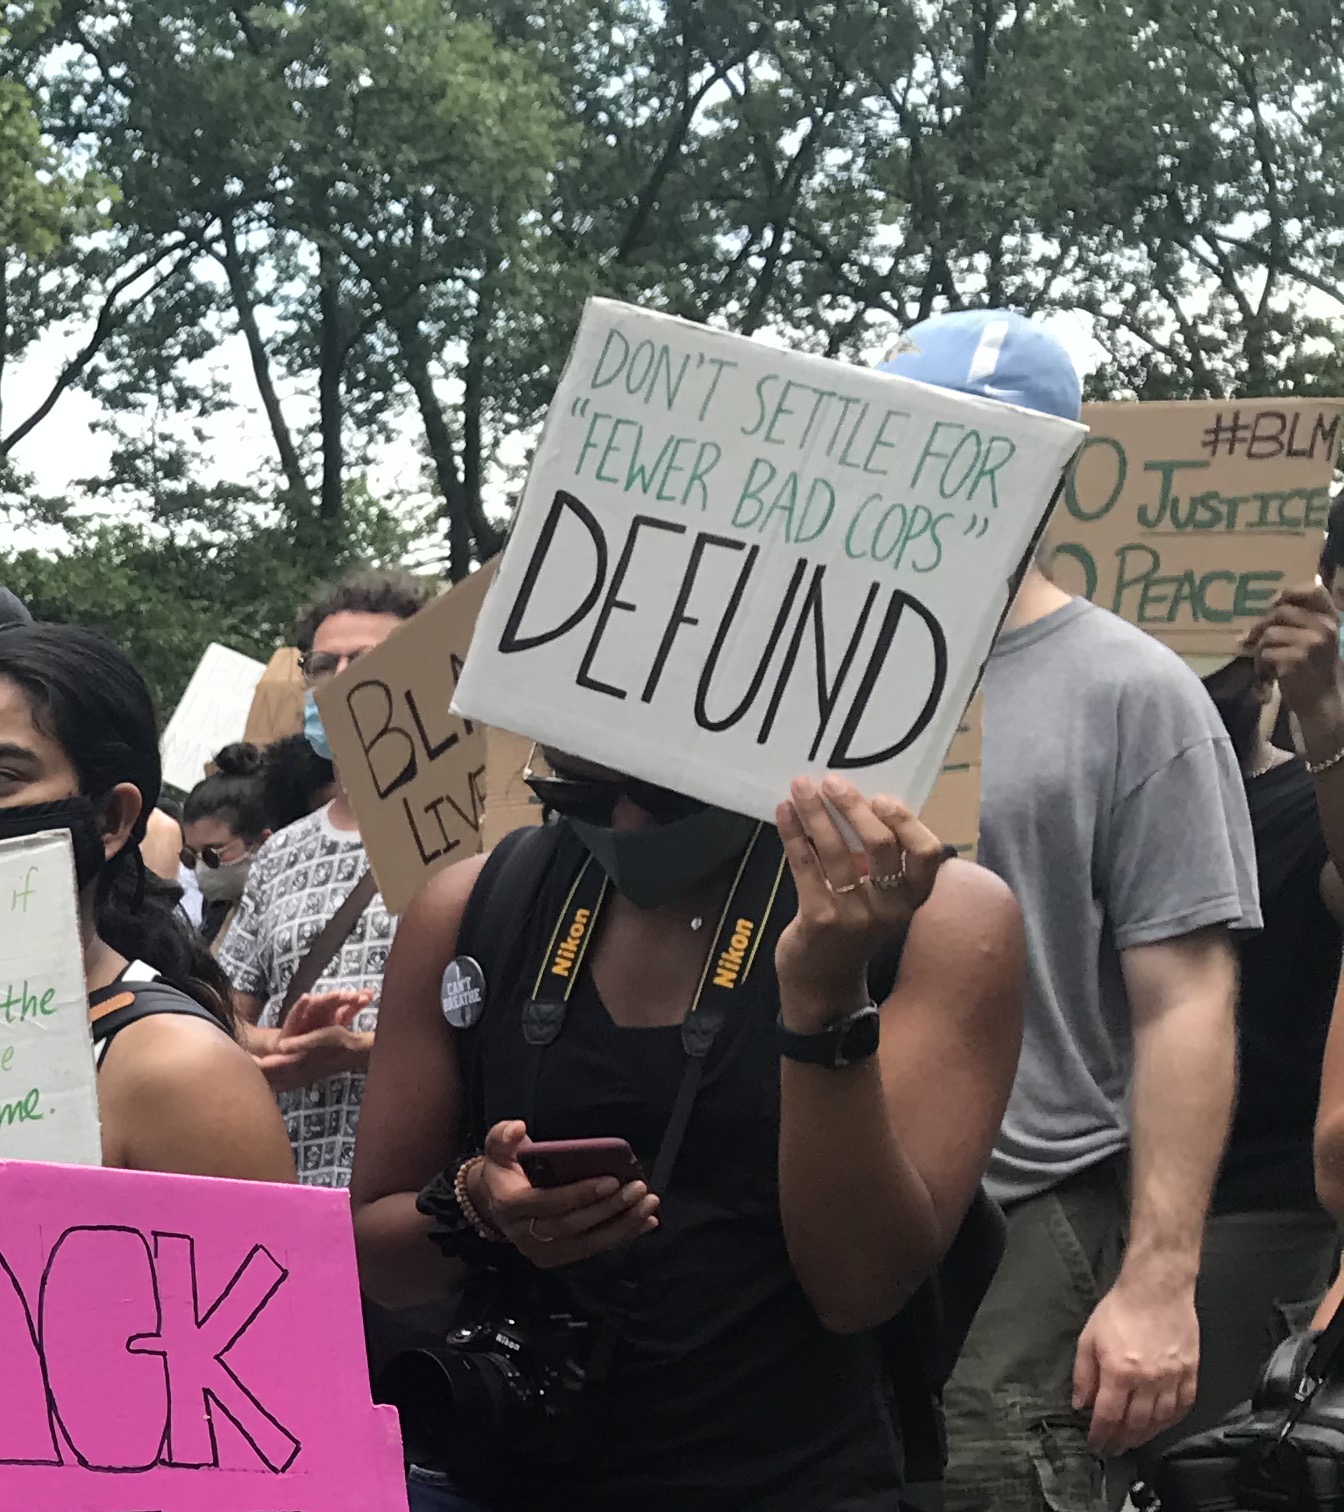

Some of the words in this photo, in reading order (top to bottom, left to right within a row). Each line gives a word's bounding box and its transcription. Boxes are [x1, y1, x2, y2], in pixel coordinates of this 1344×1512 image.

[590, 327, 739, 422] DON'T
[740, 373, 911, 476] SETTLE
[910, 420, 1017, 509] FOR
[1200, 409, 1341, 462] #BLM
[730, 456, 836, 544] BAD
[1112, 542, 1285, 624] PEACE
[498, 488, 949, 769] DEFUND
[10, 865, 40, 913] if
[551, 907, 591, 978] Nikon
[712, 917, 755, 989] Nikon
